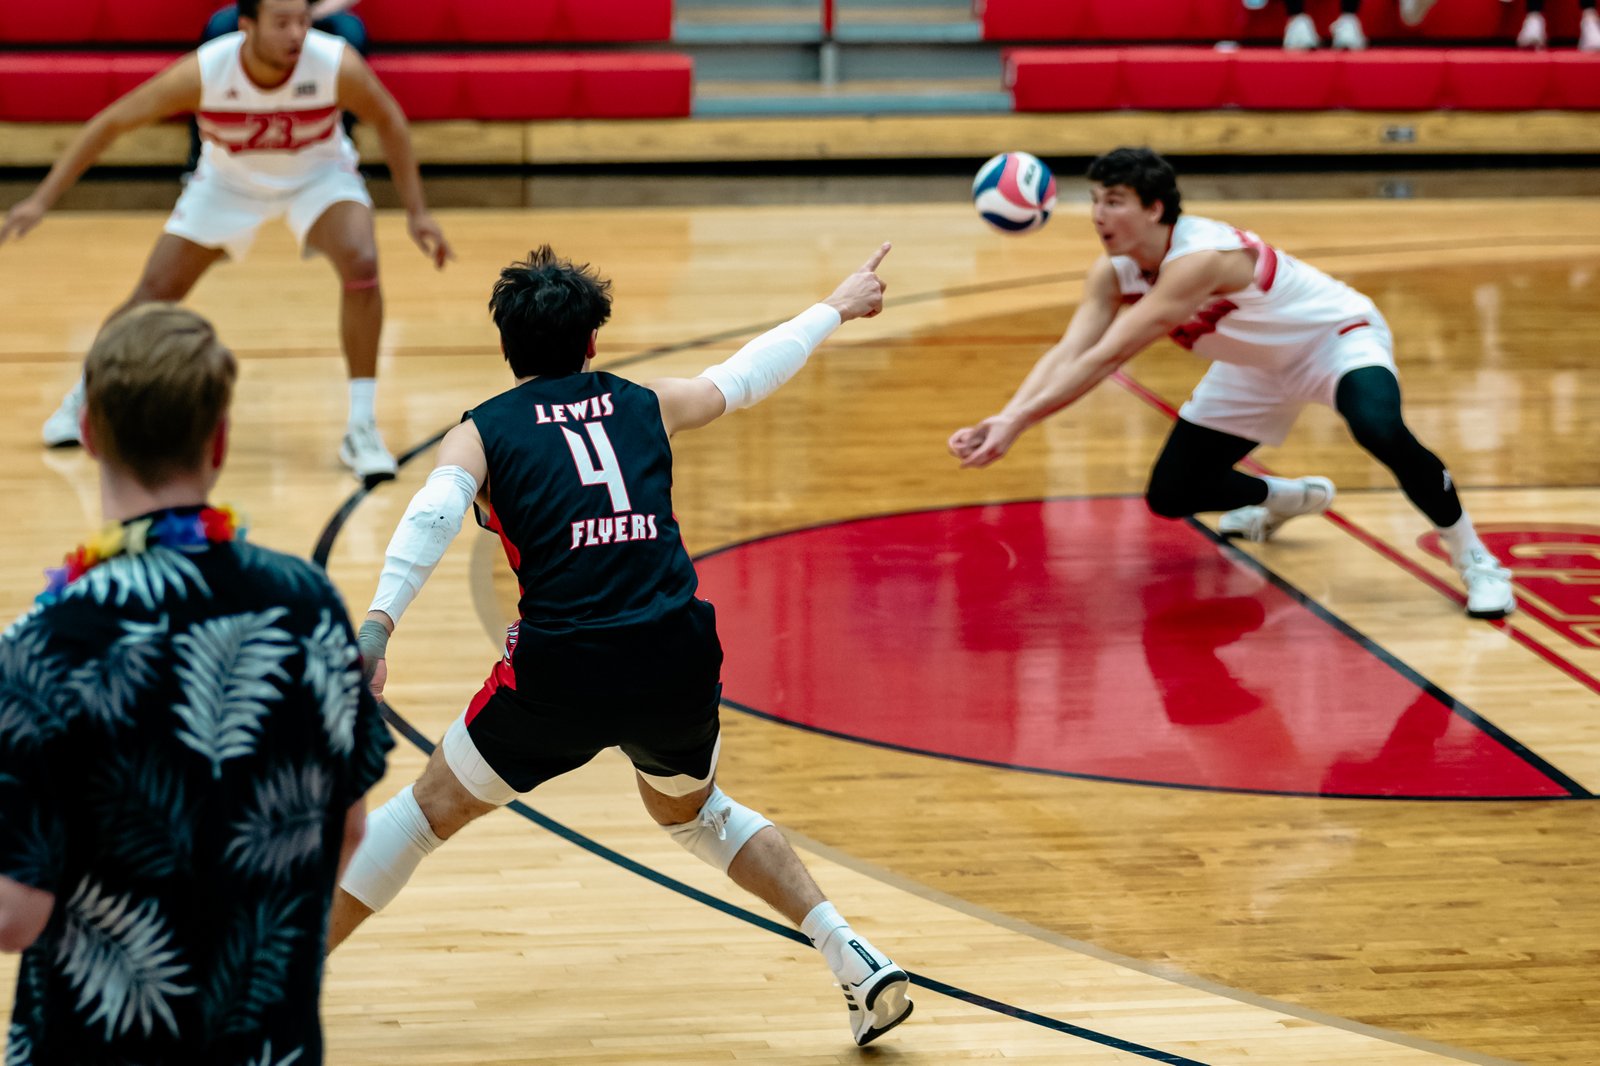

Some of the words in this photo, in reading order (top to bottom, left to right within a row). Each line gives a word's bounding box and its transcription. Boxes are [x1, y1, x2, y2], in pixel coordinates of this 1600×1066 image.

[246, 114, 294, 149] 23
[534, 392, 615, 424] LEWIS
[559, 421, 632, 513] 4
[569, 513, 658, 551] FLYERS
